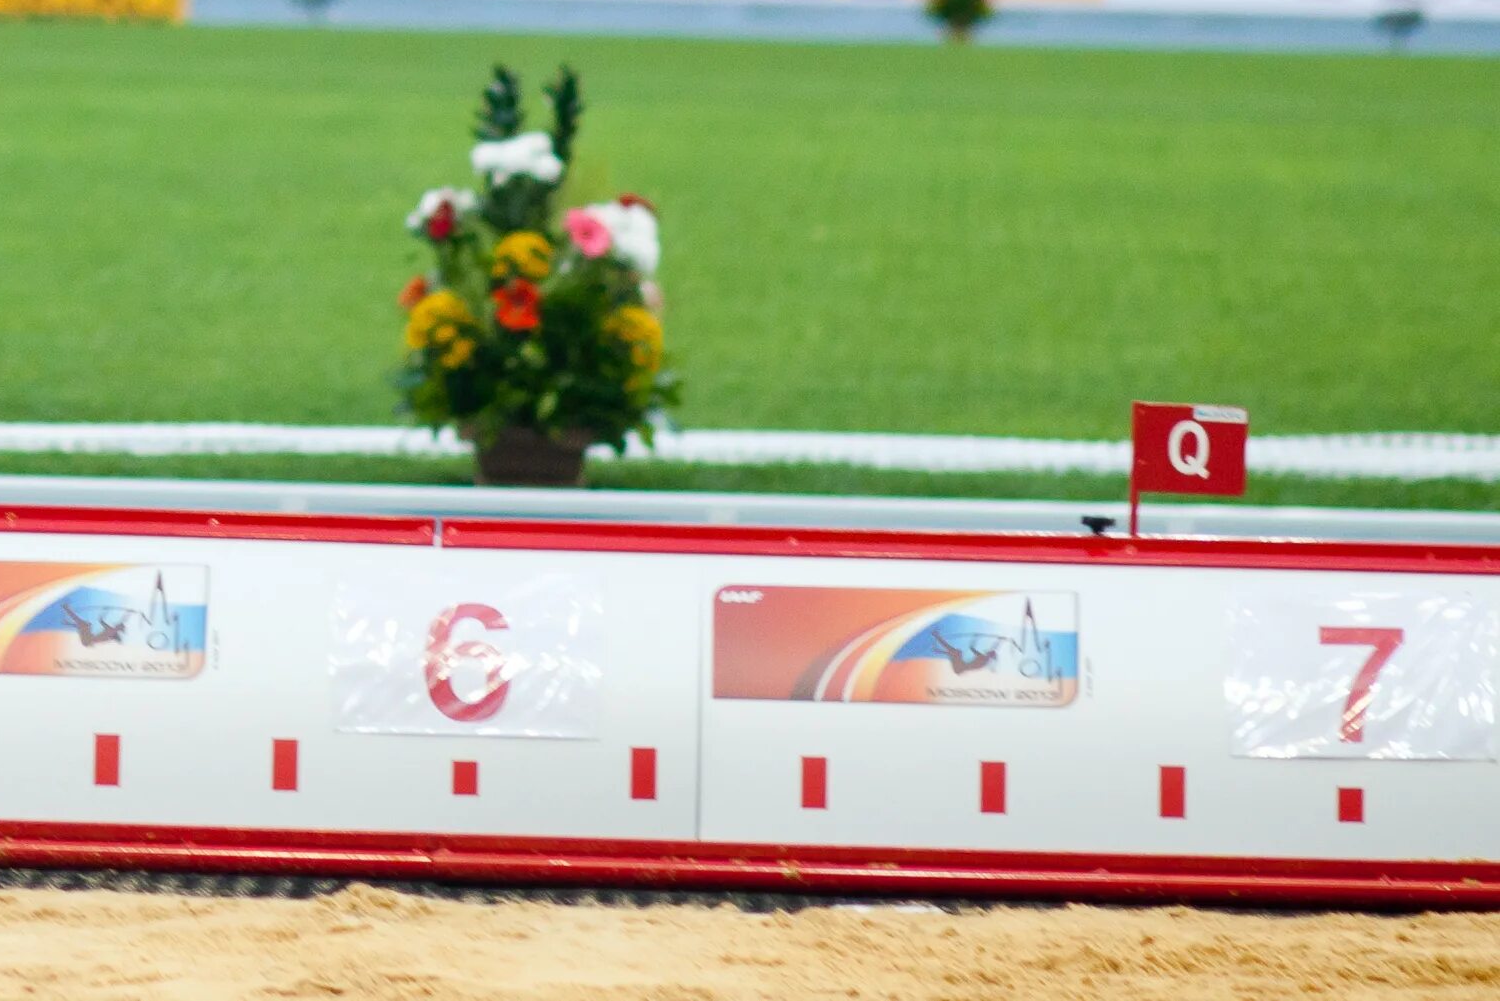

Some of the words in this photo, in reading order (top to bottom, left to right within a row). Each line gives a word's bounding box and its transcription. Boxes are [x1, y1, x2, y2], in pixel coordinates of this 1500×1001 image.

[1168, 419, 1210, 479] Q
[424, 602, 511, 722] 6
[1319, 626, 1405, 742] 7
